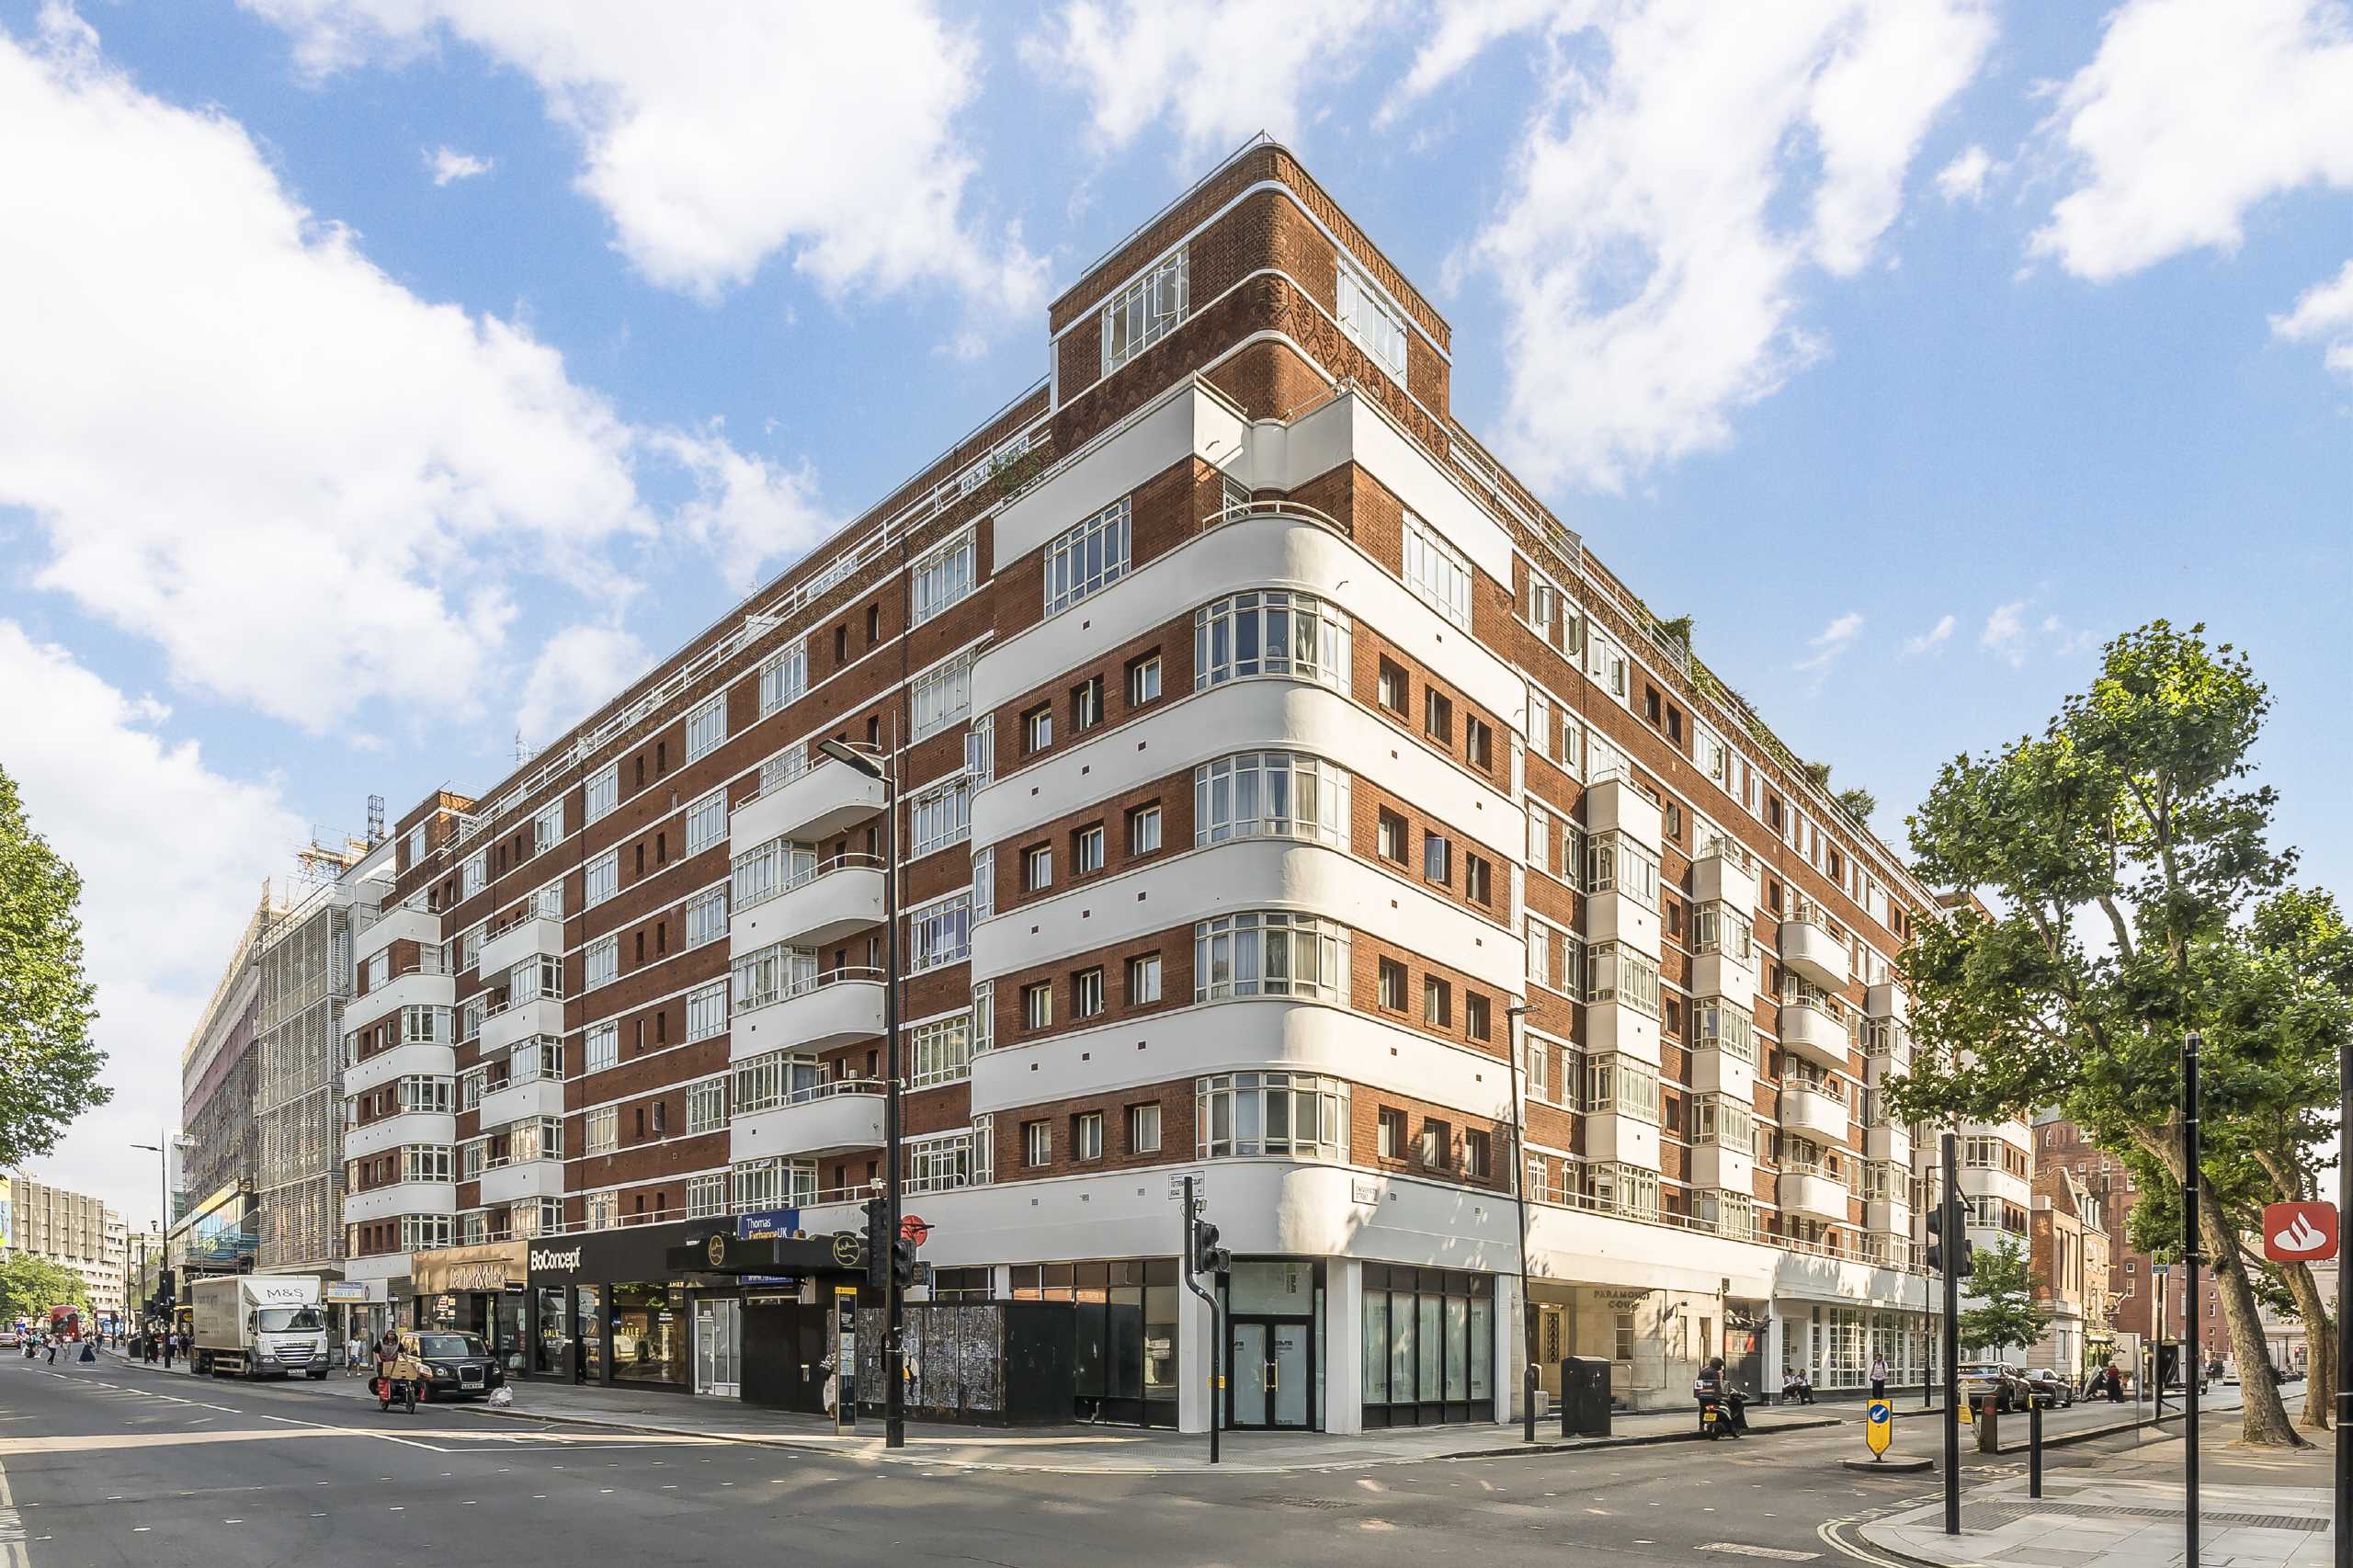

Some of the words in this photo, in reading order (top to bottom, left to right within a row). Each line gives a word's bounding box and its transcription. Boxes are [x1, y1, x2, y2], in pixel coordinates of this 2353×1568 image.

[746, 1218, 771, 1229] Thomas
[530, 1245, 581, 1273] BoConcept
[449, 1264, 507, 1290] feather&black
[267, 1288, 304, 1301] M&S
[544, 1329, 560, 1338] SALE
[620, 1327, 640, 1337] SALE
